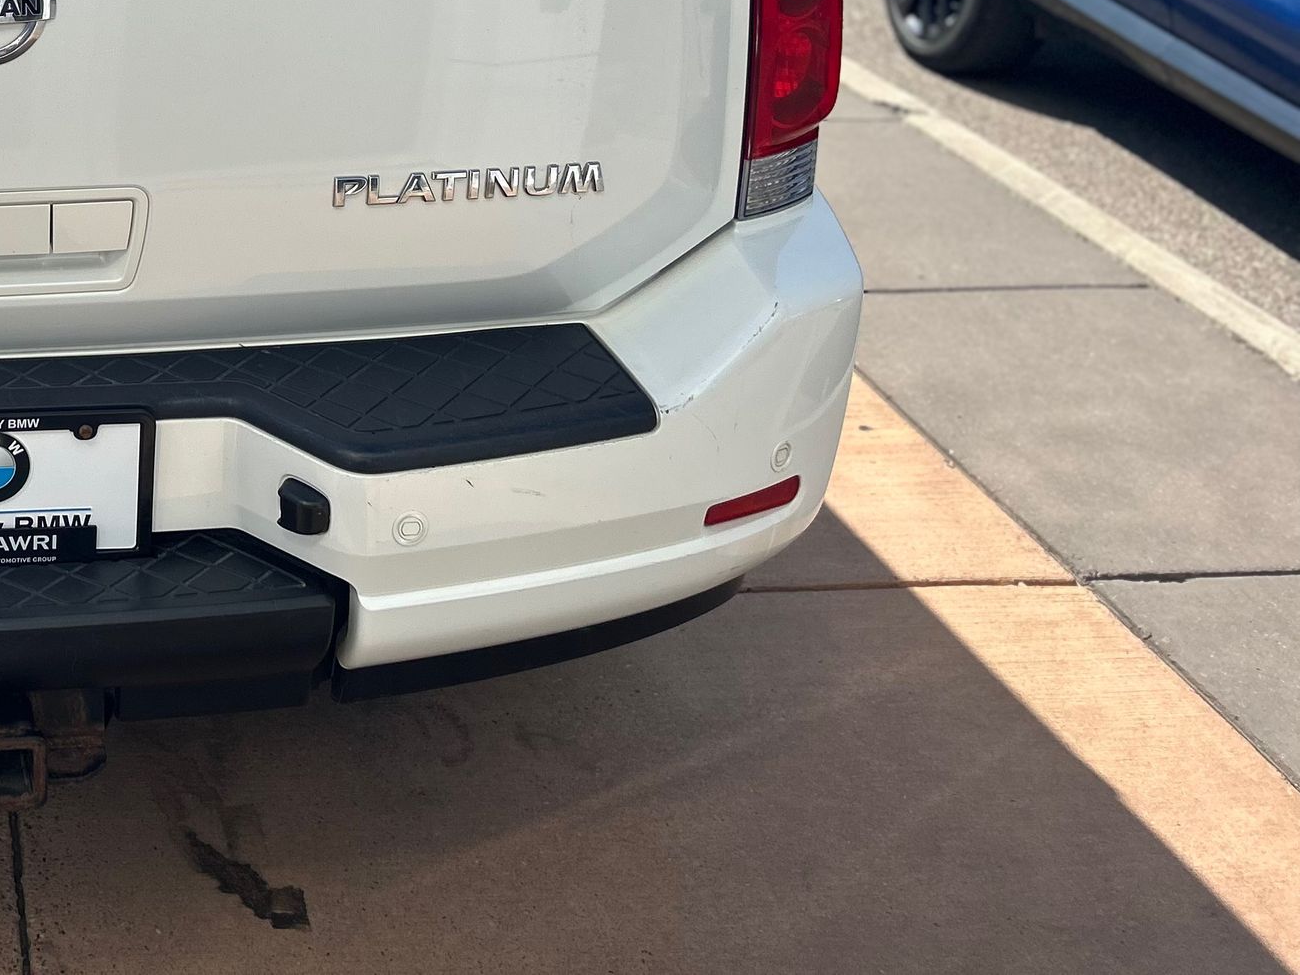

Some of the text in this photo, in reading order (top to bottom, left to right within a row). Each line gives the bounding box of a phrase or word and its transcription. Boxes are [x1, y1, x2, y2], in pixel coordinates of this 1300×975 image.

[332, 161, 605, 207] PLATINUM
[7, 417, 40, 429] BMW
[32, 555, 57, 563] GROUP
